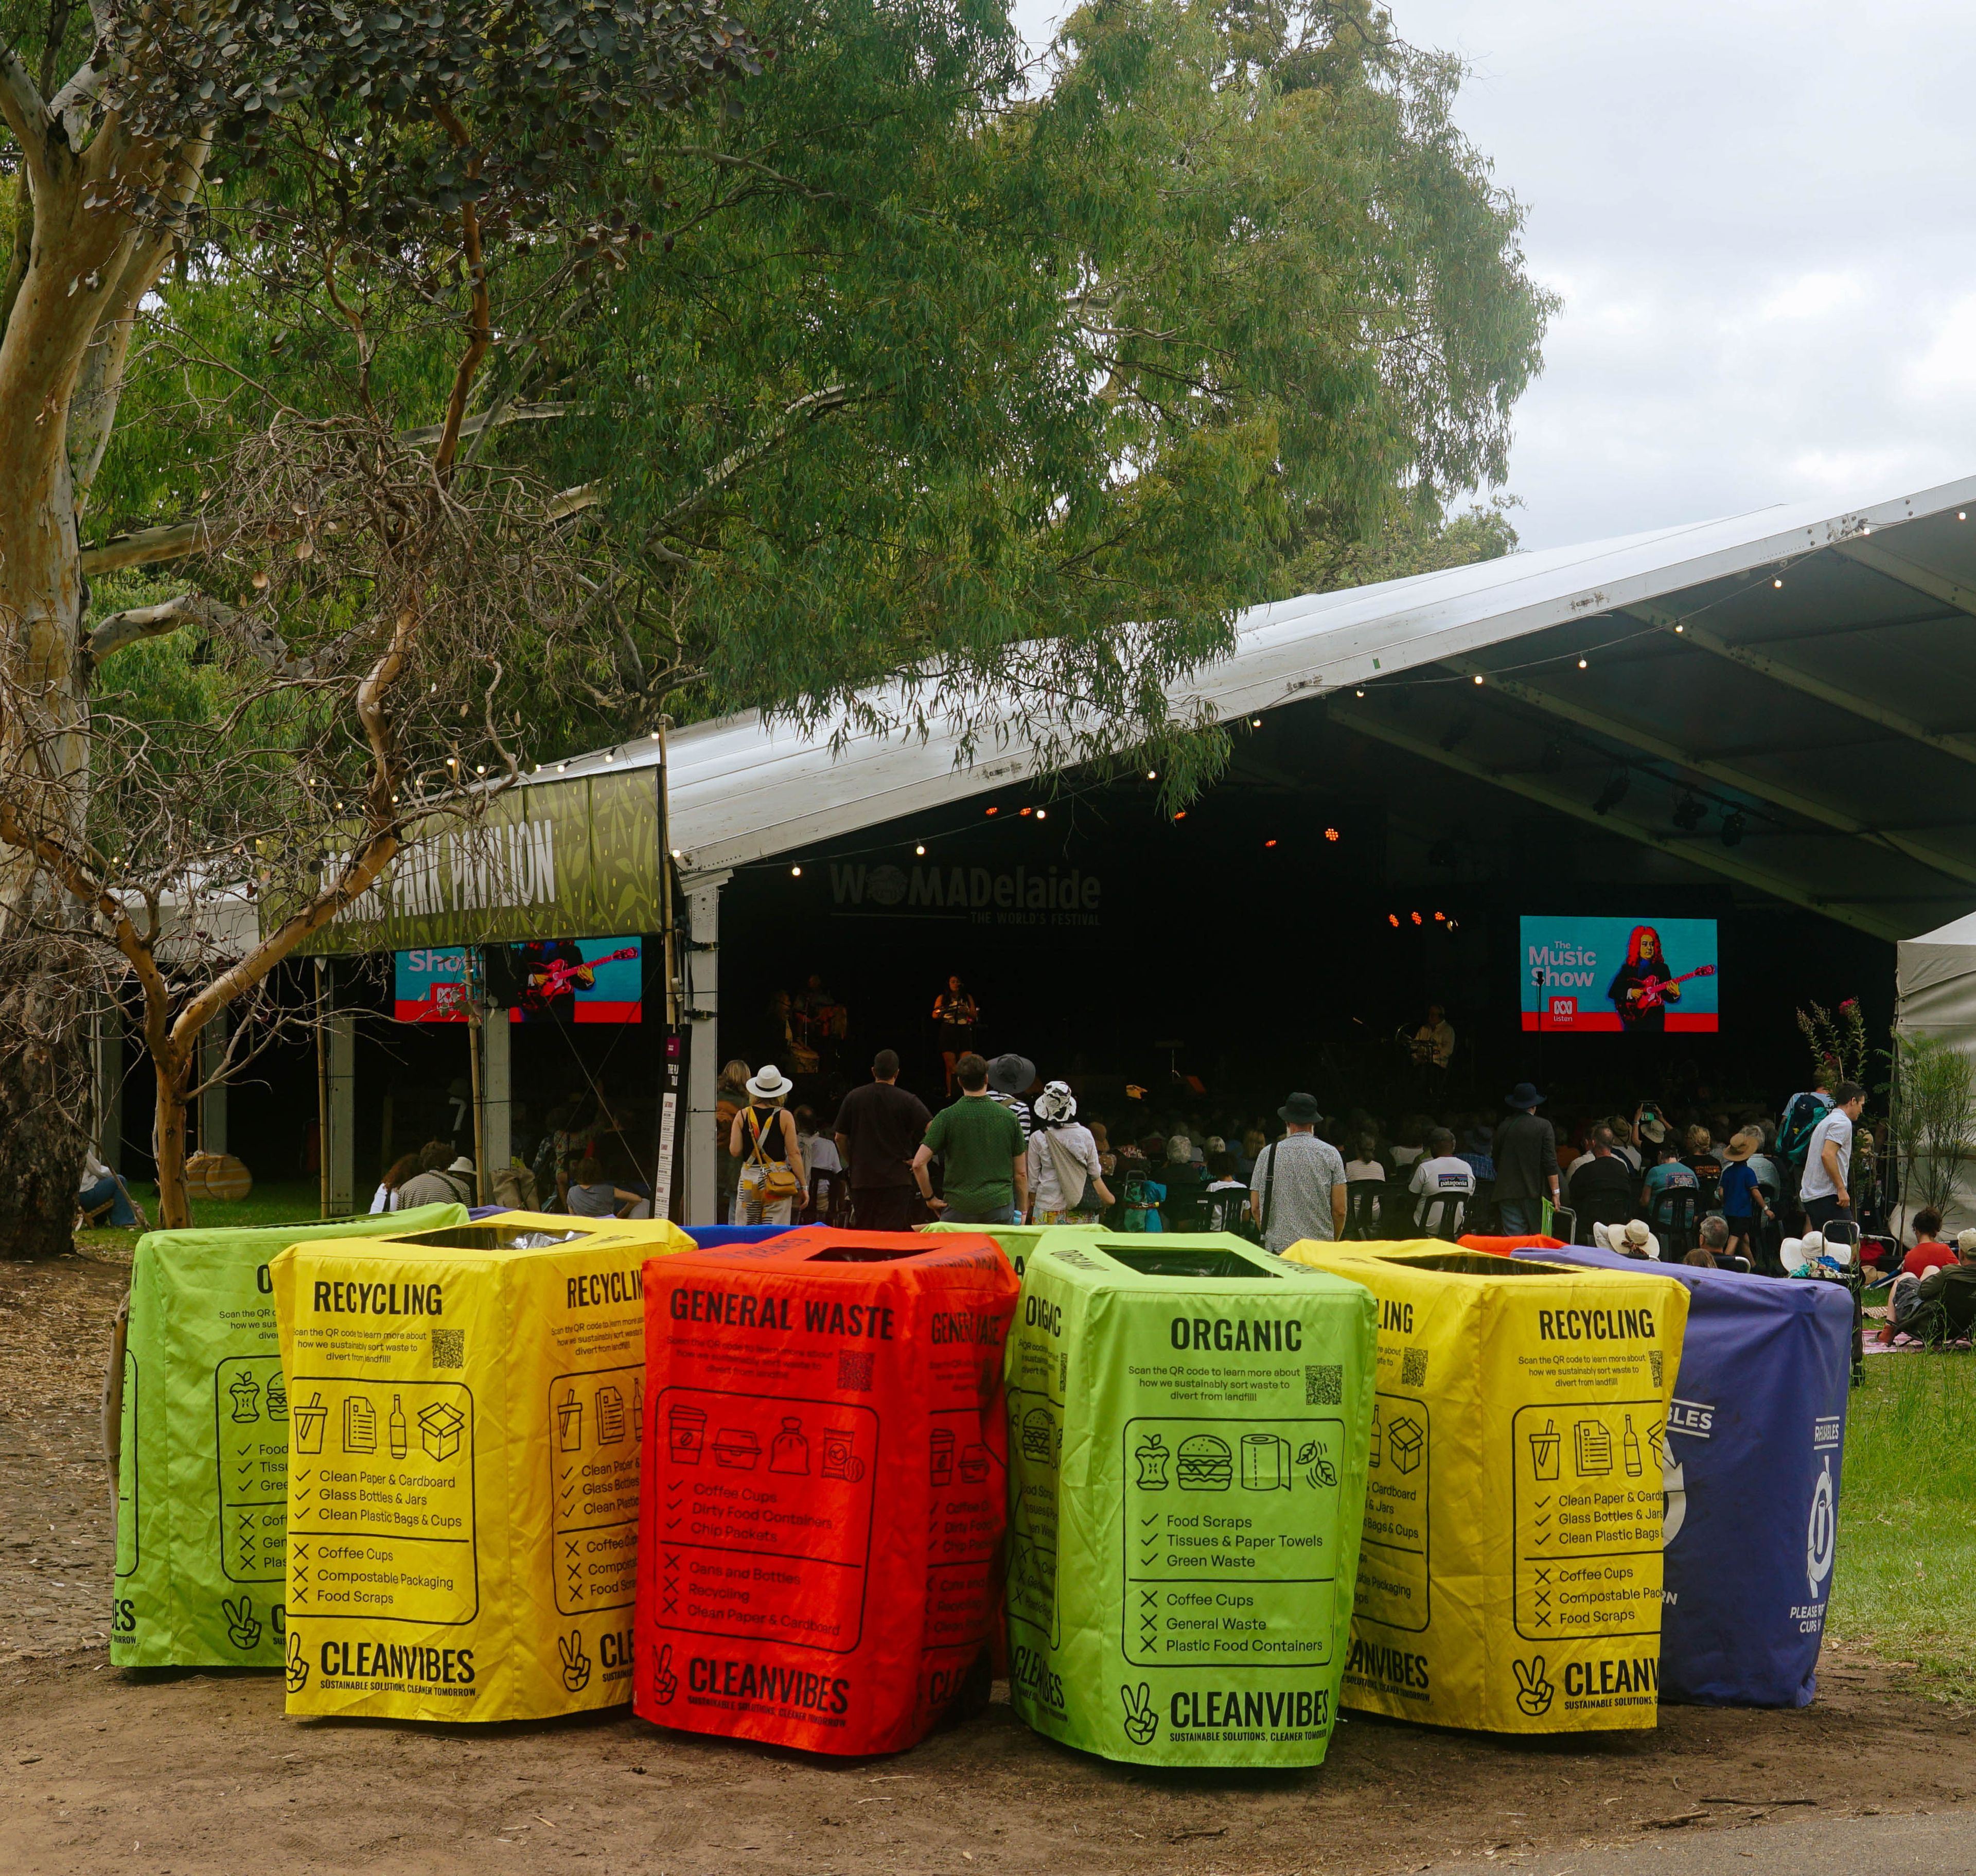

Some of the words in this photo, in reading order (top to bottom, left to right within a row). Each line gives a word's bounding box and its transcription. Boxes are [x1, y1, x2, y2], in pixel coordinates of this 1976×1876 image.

[392, 836, 444, 918] PARK
[449, 819, 555, 911] PAVILION
[971, 911, 992, 924] THE
[997, 912, 1046, 925] WORLD'S
[1051, 913, 1101, 926] FESTIVAL
[1555, 941, 1571, 949] The
[408, 949, 482, 972] Sho
[1529, 946, 1596, 966] Music
[1531, 966, 1594, 987] Show
[568, 1269, 643, 1308] RECYCLIN
[314, 1281, 442, 1315] RECYCLING
[257, 1309, 270, 1317] QR
[671, 1288, 792, 1331] GENERAL
[805, 1300, 894, 1340] WASTE
[1539, 1309, 1655, 1340] RECYCLING
[326, 1329, 339, 1337] QR
[406, 1332, 426, 1340] about
[1171, 1317, 1301, 1352] ORGANIC
[330, 1341, 366, 1352] sustainably
[368, 1342, 384, 1351] sort
[326, 1353, 351, 1361] divert
[1553, 1356, 1564, 1364] QR
[1128, 1366, 1150, 1374] Scan
[1170, 1367, 1184, 1375] QR
[1187, 1367, 1209, 1376] code
[1224, 1368, 1246, 1377] learn
[1274, 1368, 1300, 1377] about
[1139, 1379, 1158, 1387] how
[1175, 1379, 1228, 1390] sustainably
[1555, 1379, 1577, 1387] divert
[1201, 1392, 1222, 1401] from
[1225, 1392, 1257, 1402] landfill!
[259, 1444, 288, 1455] Food
[582, 1465, 611, 1477] Clean
[320, 1470, 357, 1482] Clean
[360, 1472, 385, 1485] Paper
[399, 1474, 455, 1488] Cardboard
[319, 1489, 357, 1500] Glass
[360, 1490, 393, 1503] Bottles
[396, 1494, 402, 1503] &
[405, 1494, 427, 1505] Jars
[583, 1483, 612, 1496] Glass
[694, 1483, 739, 1499] Coffee
[742, 1489, 777, 1503] Cups
[1372, 1482, 1416, 1500] Cardboard
[1376, 1501, 1394, 1514] Jars
[1559, 1495, 1591, 1507] Clean
[1595, 1493, 1624, 1507] Paper
[1627, 1493, 1634, 1502] &
[584, 1501, 615, 1515] Clean
[693, 1502, 724, 1518] Dirty
[728, 1507, 759, 1520] Food
[763, 1511, 832, 1529] Containers
[319, 1508, 357, 1520] Clean
[361, 1510, 392, 1523] Plastic
[395, 1512, 419, 1527] Bags
[422, 1515, 428, 1525] &
[431, 1515, 462, 1529] Cups
[1167, 1515, 1198, 1527] Food
[1203, 1515, 1252, 1530] Scraps
[1559, 1513, 1591, 1525] Glass
[1594, 1511, 1633, 1523] Bottles
[1636, 1510, 1643, 1519] &
[1646, 1508, 1663, 1519] Jars
[691, 1523, 722, 1536] Chip
[726, 1527, 777, 1542] Packets
[1396, 1524, 1418, 1538] Cups
[1559, 1532, 1592, 1544] Clean
[1596, 1529, 1632, 1542] Plastic
[1635, 1528, 1659, 1542] Bags
[1167, 1535, 1219, 1547] Tissues
[1222, 1536, 1231, 1547] &
[1236, 1535, 1275, 1550] Paper
[1279, 1535, 1322, 1547] Towels
[318, 1547, 364, 1559] Coffee
[366, 1548, 393, 1563] Cups
[1167, 1554, 1207, 1567] Green
[1211, 1555, 1255, 1567] Waste
[317, 1569, 398, 1584] Compostable
[401, 1574, 453, 1590] Packaging
[690, 1562, 722, 1576] Cans
[726, 1567, 750, 1579] and
[753, 1569, 801, 1585] Bottles
[1560, 1570, 1601, 1582] Coffee
[1604, 1568, 1633, 1581] Cups
[590, 1581, 618, 1596] Food
[689, 1584, 749, 1603] Recycling
[1372, 1579, 1410, 1599] Packaging
[317, 1590, 349, 1602] Food
[354, 1590, 393, 1605] Scraps
[1167, 1594, 1212, 1606] Coffee
[1216, 1594, 1254, 1608] Cups
[1560, 1588, 1640, 1605] Compostable
[687, 1605, 724, 1619] Clean
[728, 1609, 766, 1624] Paper
[781, 1616, 840, 1636] Cardboard
[1167, 1618, 1219, 1630] General
[1223, 1618, 1266, 1630] Waste
[1560, 1612, 1590, 1624] Food
[1594, 1611, 1635, 1622] Scraps
[1167, 1639, 1209, 1652] Plastic
[1214, 1639, 1248, 1651] Food
[1252, 1639, 1322, 1652] Containers
[321, 1641, 475, 1684] CLEANVIBES
[321, 1679, 368, 1690] SUSTAINABLE
[408, 1685, 432, 1695] CLEANER
[434, 1688, 475, 1696] TOMORROW
[689, 1658, 849, 1714] CLEANVIBES
[1170, 1689, 1329, 1728] CLEANVIBES
[1565, 1698, 1612, 1710] SUSTAINABLE
[1615, 1697, 1653, 1706] SOLUTIONS,
[1170, 1732, 1220, 1742] SUSTAINABLE
[1223, 1731, 1267, 1742] SOLUTIONS,
[1271, 1732, 1302, 1741] CLEANER
